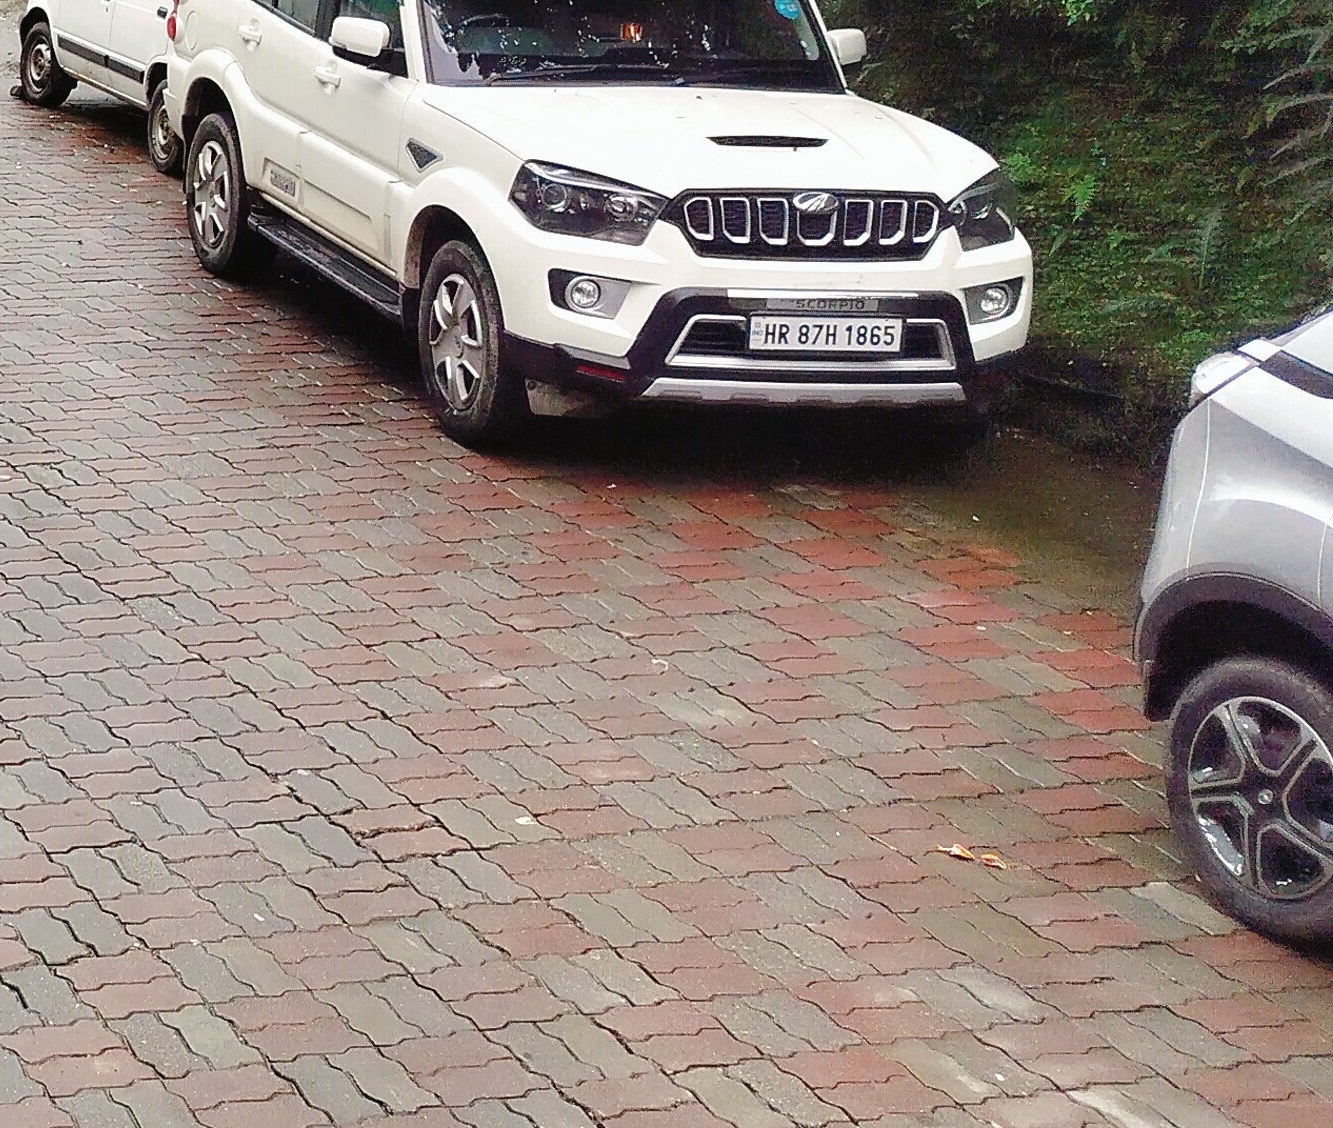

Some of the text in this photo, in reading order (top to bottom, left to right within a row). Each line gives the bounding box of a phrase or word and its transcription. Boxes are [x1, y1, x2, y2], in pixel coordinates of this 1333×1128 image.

[795, 299, 866, 310] SCORPIO
[763, 323, 895, 346] HR 87H 1865
